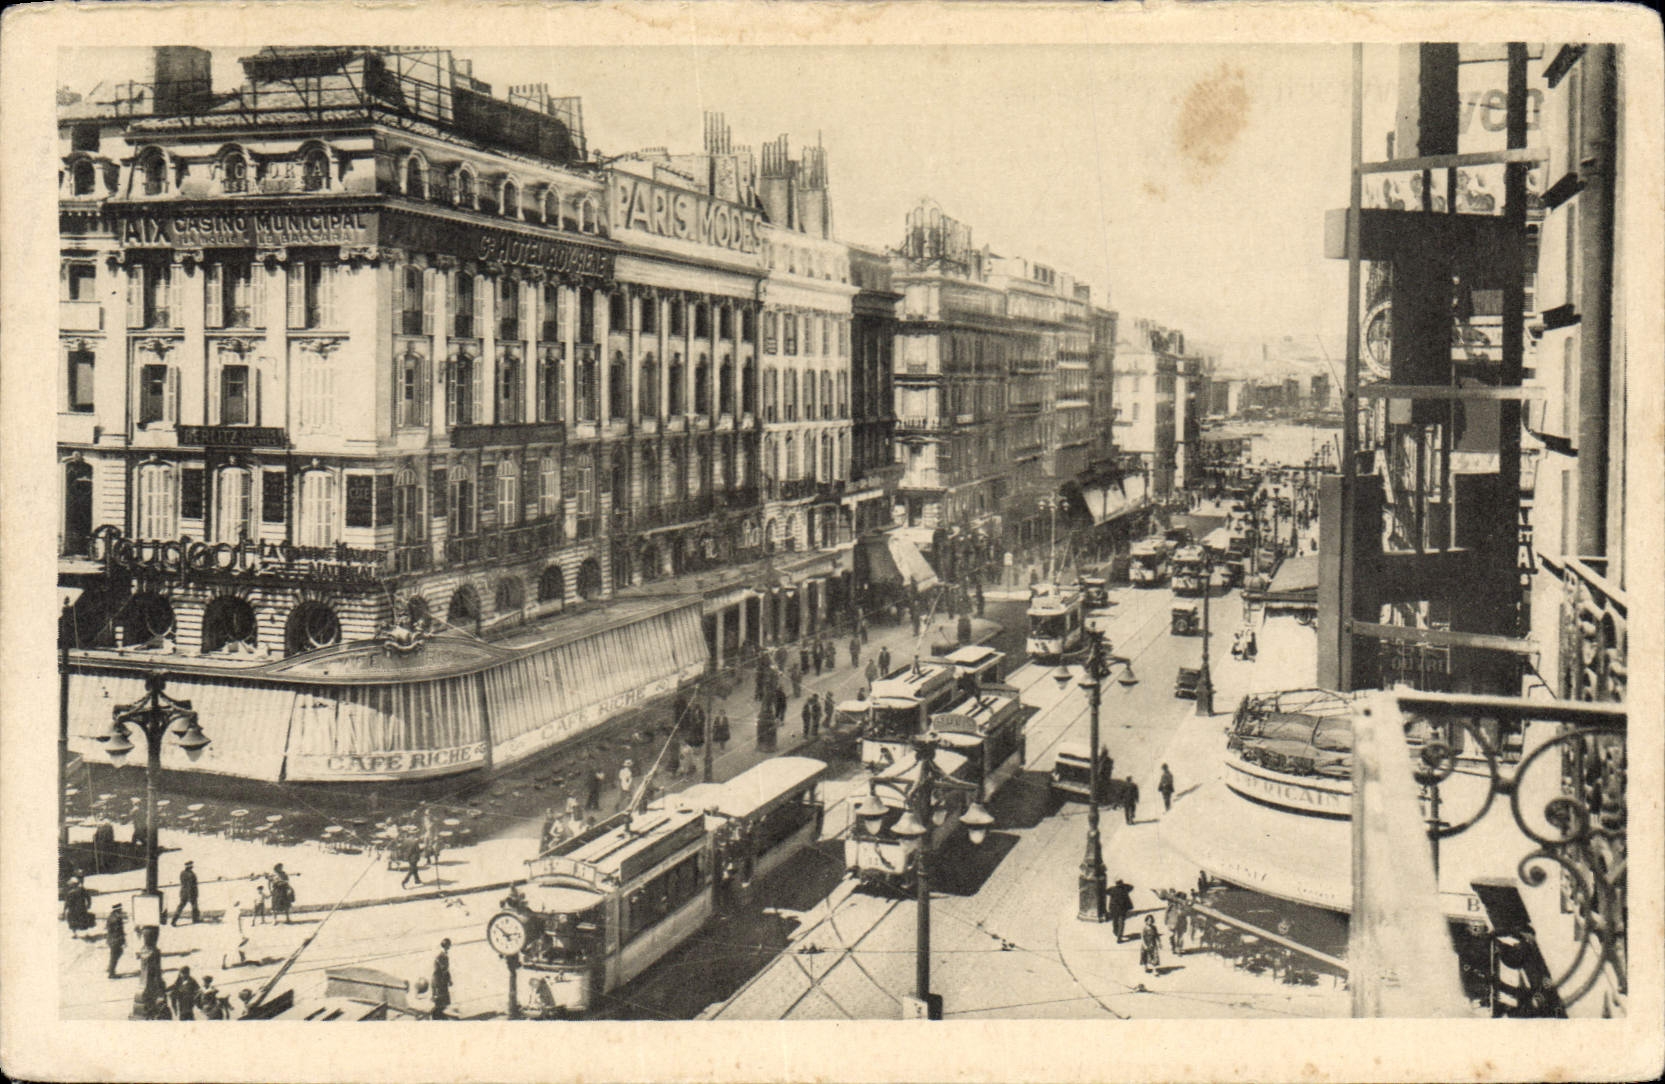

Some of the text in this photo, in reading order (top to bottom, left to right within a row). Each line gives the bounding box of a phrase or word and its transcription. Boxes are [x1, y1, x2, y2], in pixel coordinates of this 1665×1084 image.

[122, 213, 367, 246] AIX CASINO MUNICIPAL
[699, 199, 763, 255] MODES
[409, 746, 472, 770] RICHE
